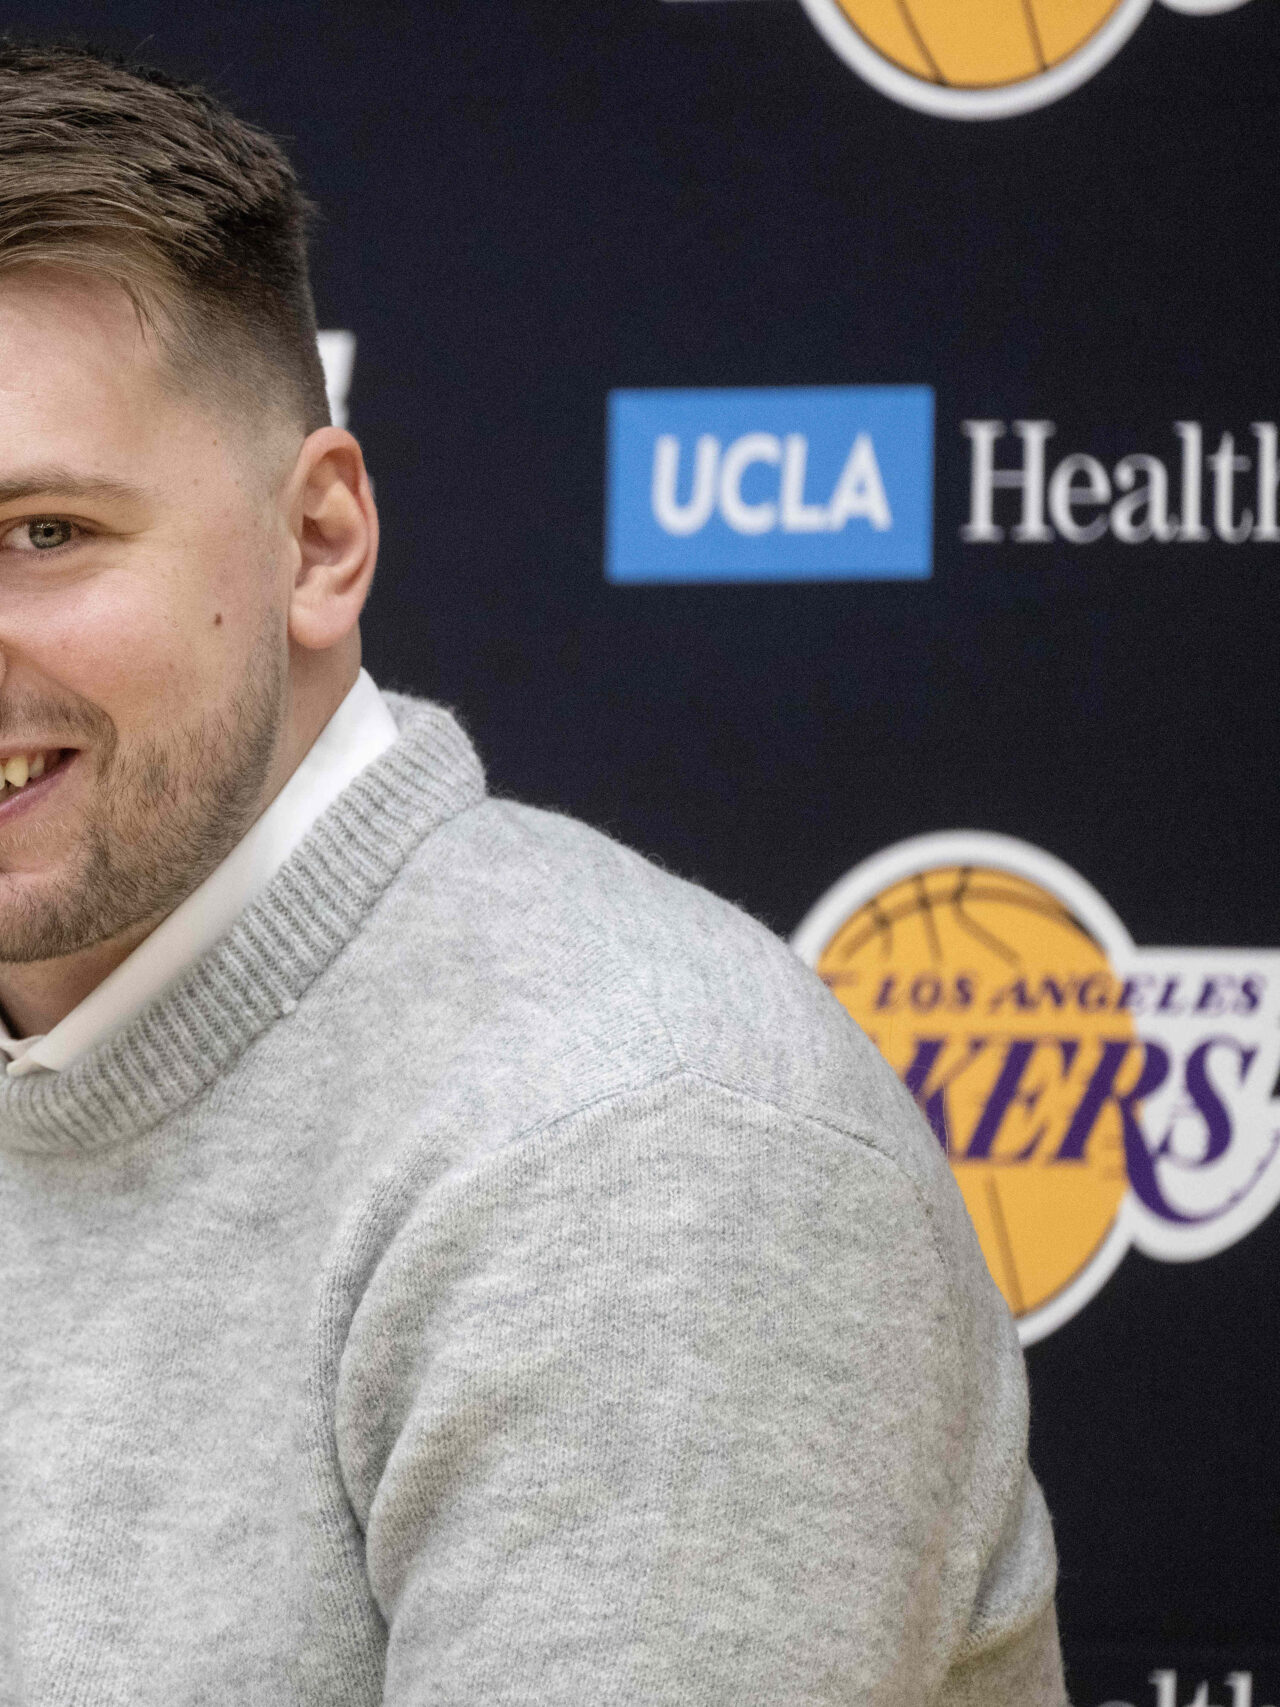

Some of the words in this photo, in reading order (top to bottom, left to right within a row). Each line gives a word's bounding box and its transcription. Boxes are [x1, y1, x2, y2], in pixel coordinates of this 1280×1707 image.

[652, 430, 894, 537] UCLA
[871, 973, 979, 1016] LOS
[986, 972, 1267, 1018] ANGELES
[902, 1034, 1280, 1226] KERS
